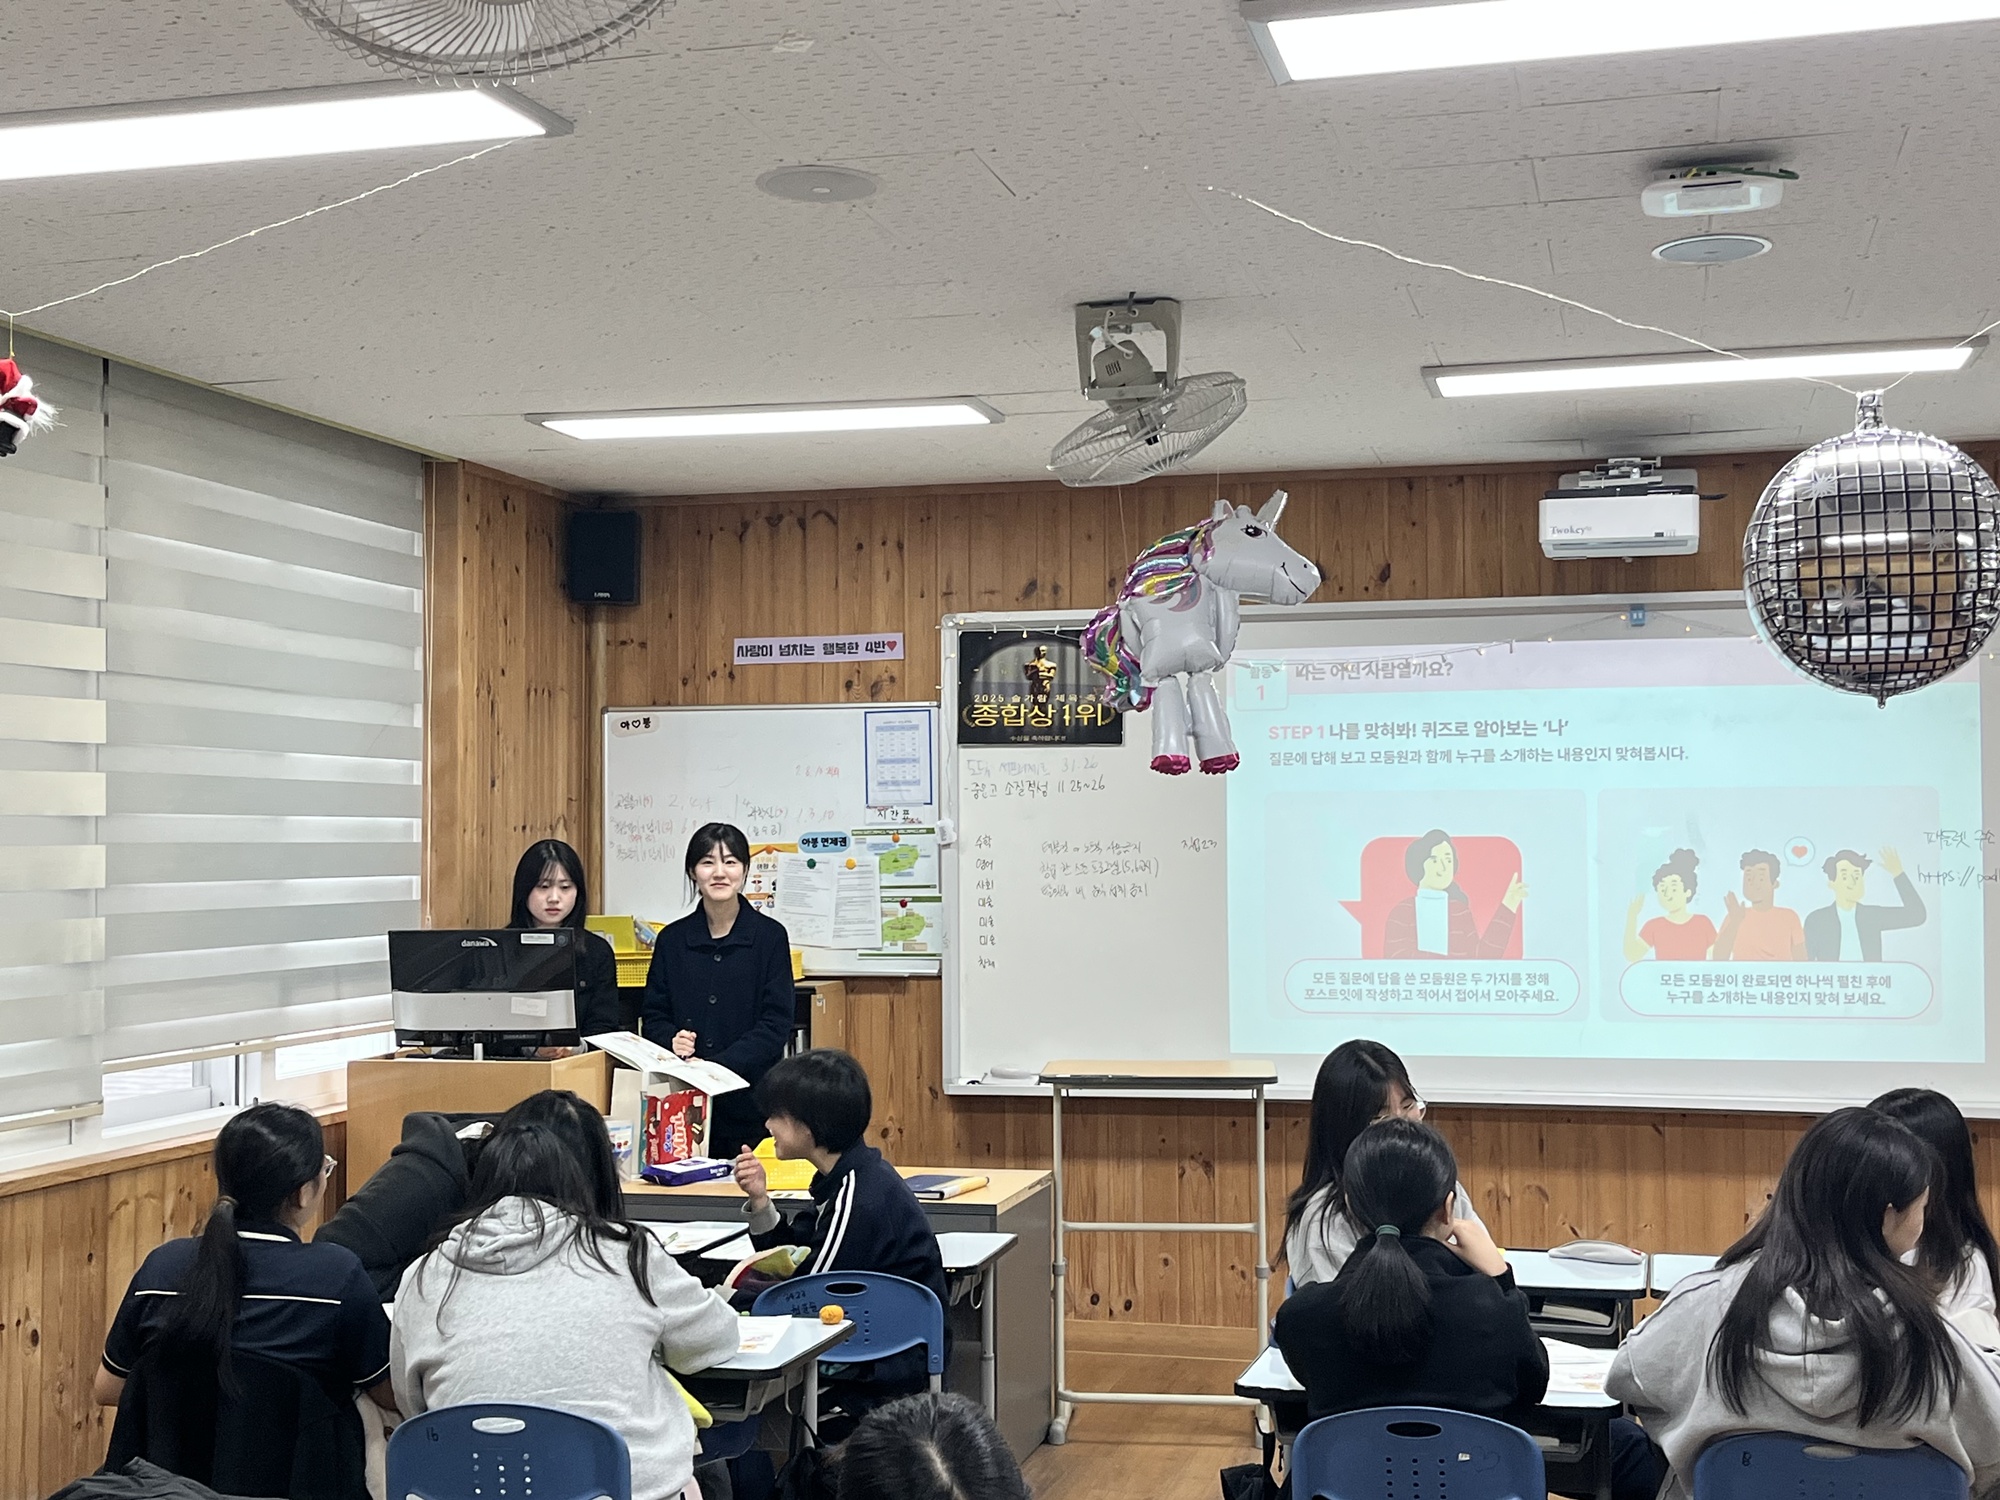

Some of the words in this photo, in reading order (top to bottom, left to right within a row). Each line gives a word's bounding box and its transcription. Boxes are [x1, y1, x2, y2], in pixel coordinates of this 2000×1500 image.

[1550, 525, 1586, 536] Twokey
[736, 644, 773, 658] 사랑이
[778, 643, 815, 657] 넘치는
[822, 641, 860, 655] 행복한
[865, 640, 886, 654] 4반
[974, 694, 1005, 704] 2025
[971, 703, 1057, 728] 종합상
[1062, 702, 1102, 727] 1위
[1268, 725, 1314, 740] STEP
[1317, 725, 1326, 739] 1
[1329, 722, 1361, 740] 나를
[1364, 721, 1417, 740] 맞혀봐!
[1421, 721, 1470, 739] 퀴즈로
[1473, 719, 1539, 738] 알아보는
[1269, 752, 1308, 767] 질문에
[1311, 751, 1337, 766] 답해
[1340, 751, 1366, 765] 보고
[1369, 750, 1422, 765] 모둠원과
[1426, 749, 1452, 764] 함께
[1456, 749, 1496, 763] 누구를
[1500, 747, 1554, 763] 소개하는
[1557, 746, 1612, 762] 내용인지
[1615, 745, 1690, 762] 맞혀봅시다.
[975, 834, 993, 849] 수학
[1973, 829, 1996, 851] 주소
[975, 858, 994, 871] 영어
[976, 878, 994, 891] 사회
[978, 914, 995, 928] 미술
[461, 938, 490, 948] danawa
[1312, 972, 1337, 985] 모든
[1338, 971, 1375, 986] 질문에
[1377, 972, 1402, 986] 답을
[1404, 972, 1417, 985] 쓴
[1419, 972, 1469, 986] 모둠원은
[1470, 972, 1483, 986] 두
[1485, 972, 1522, 986] 가지를
[1524, 972, 1550, 986] 정해
[1659, 974, 1686, 987] 모든
[1688, 973, 1739, 988] 모둠원이
[1741, 974, 1793, 988] 완료되면
[1795, 974, 1834, 989] 하나씩
[1836, 974, 1863, 989] 펼친
[1865, 974, 1892, 989] 후에
[1303, 988, 1363, 1002] 포스트잇에
[1365, 988, 1414, 1002] 작성하고
[1415, 988, 1453, 1002] 적어서
[1454, 989, 1492, 1003] 접어서
[1494, 989, 1560, 1003] 모아주세요.
[1666, 990, 1705, 1004] 누구를
[1706, 991, 1758, 1005] 소개하는
[1760, 991, 1812, 1005] 내용인지
[1814, 991, 1841, 1005] 맞혀
[1843, 991, 1886, 1006] 보세요.
